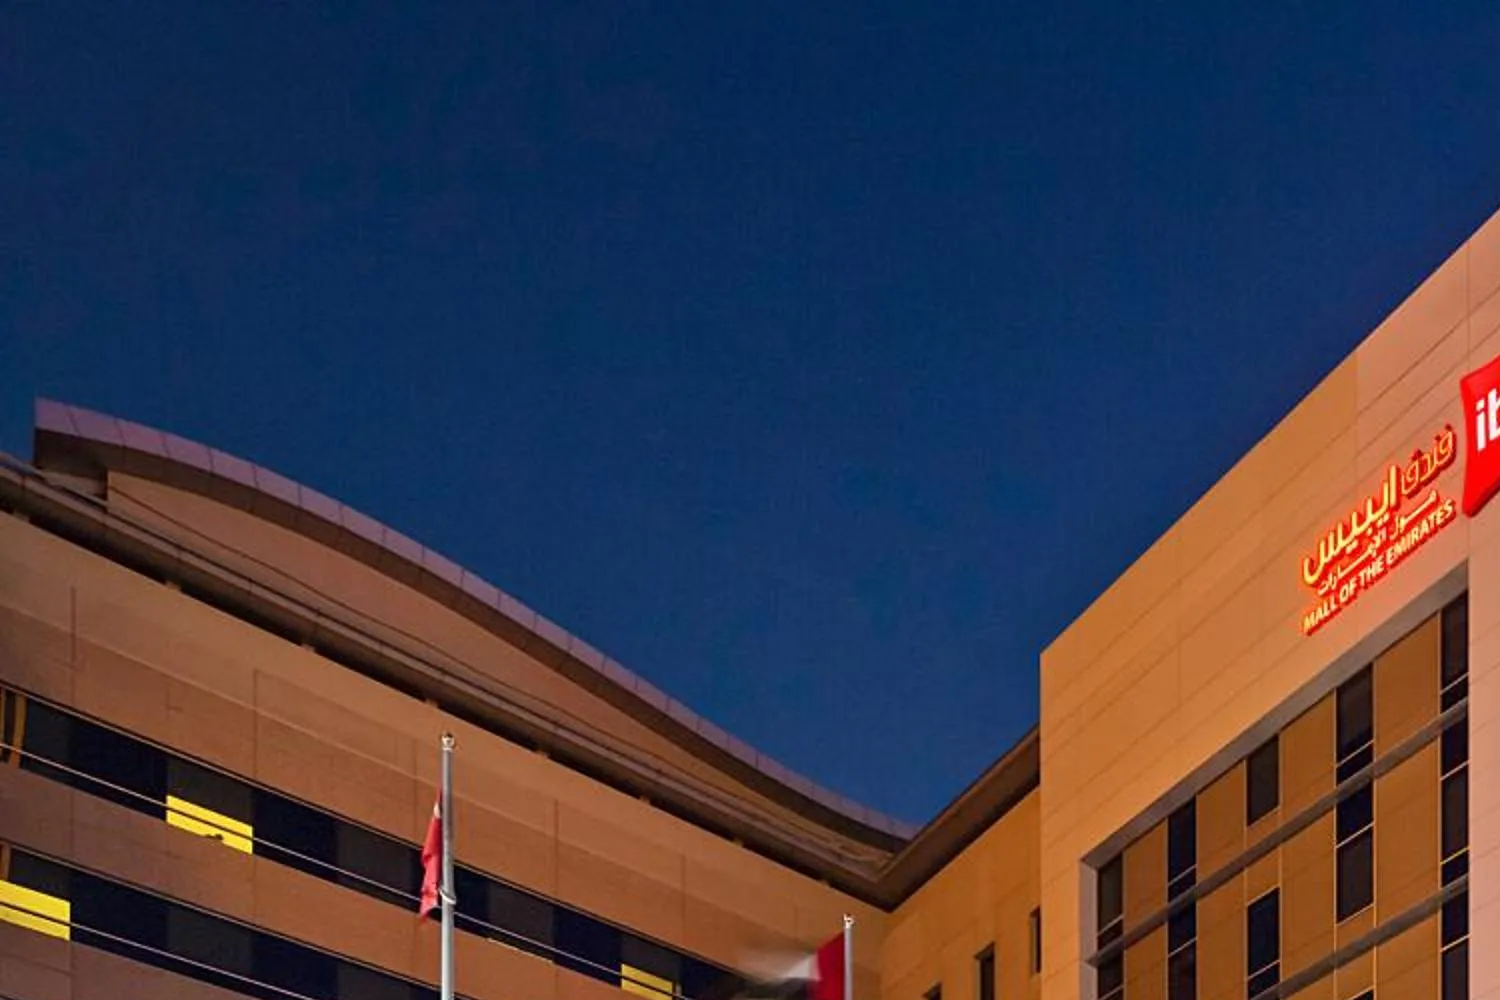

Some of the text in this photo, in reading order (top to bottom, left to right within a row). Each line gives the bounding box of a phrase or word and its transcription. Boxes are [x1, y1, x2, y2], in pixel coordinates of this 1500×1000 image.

[1402, 424, 1456, 497] فندق
[1303, 499, 1455, 634] MALL OF THE EMIRATES
